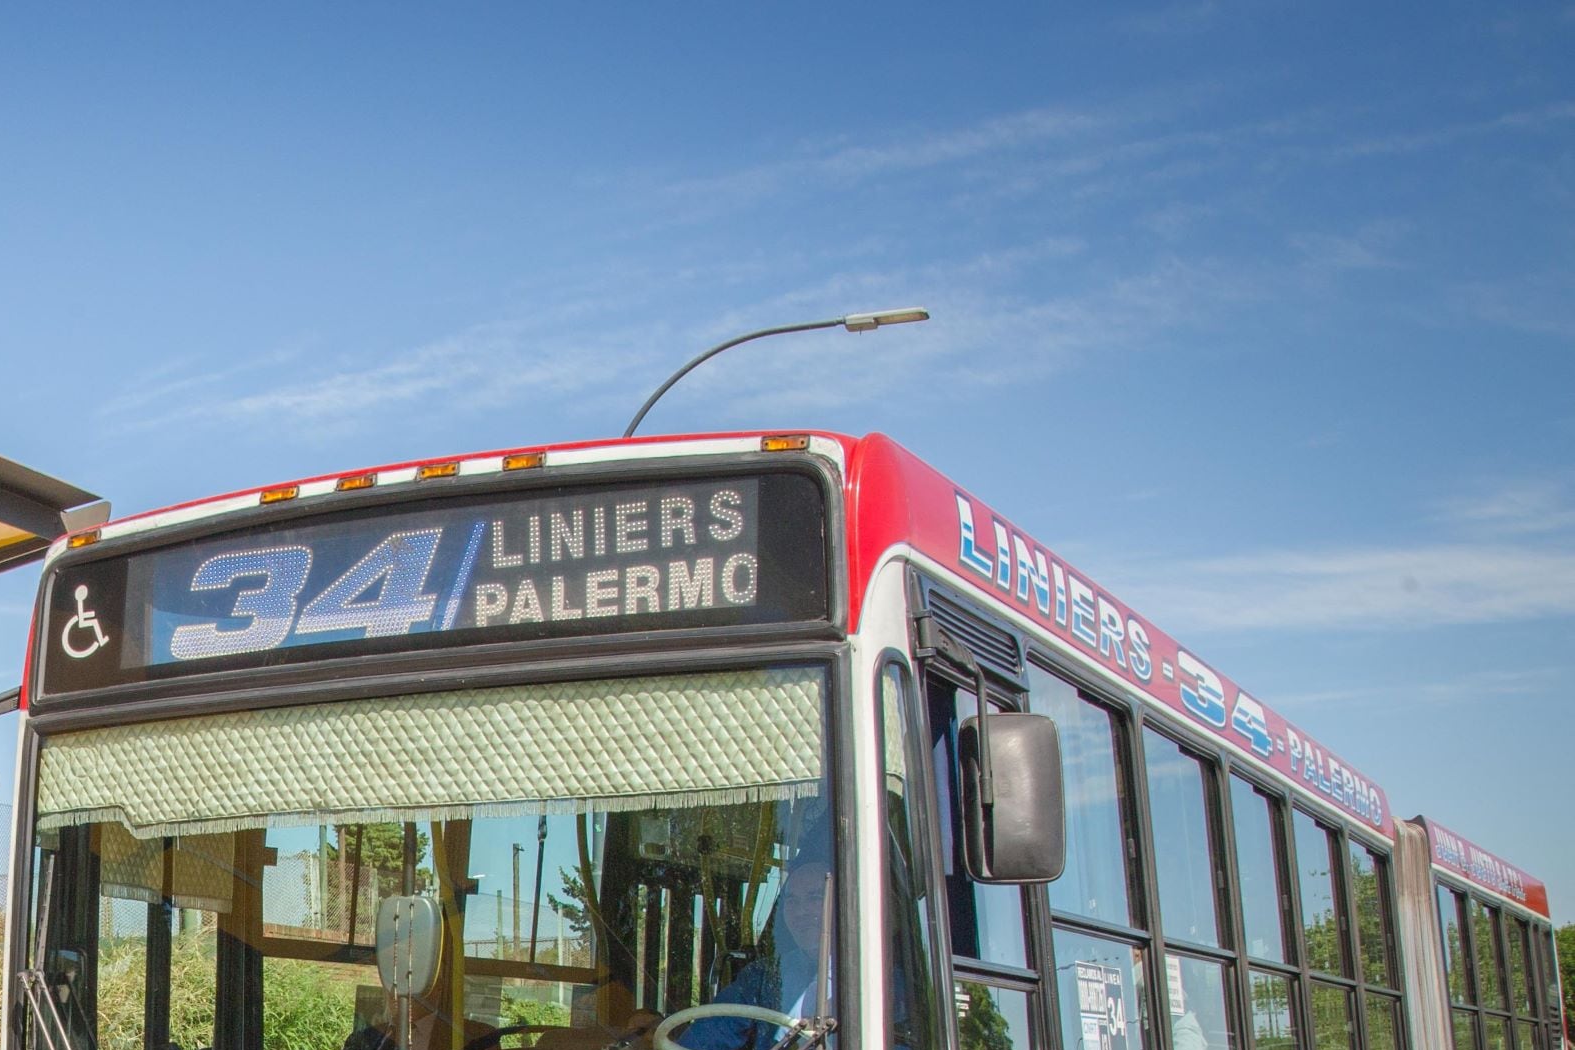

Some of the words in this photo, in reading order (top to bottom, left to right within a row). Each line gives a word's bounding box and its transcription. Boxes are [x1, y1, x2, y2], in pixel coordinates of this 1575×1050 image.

[491, 489, 744, 569] LINIERS
[170, 527, 443, 661] 34
[475, 553, 758, 628] PALERMO
[955, 492, 1152, 681] LINIERS
[1177, 649, 1273, 758] 34
[1285, 726, 1383, 827] PALERMO
[1107, 997, 1125, 1037] 34
